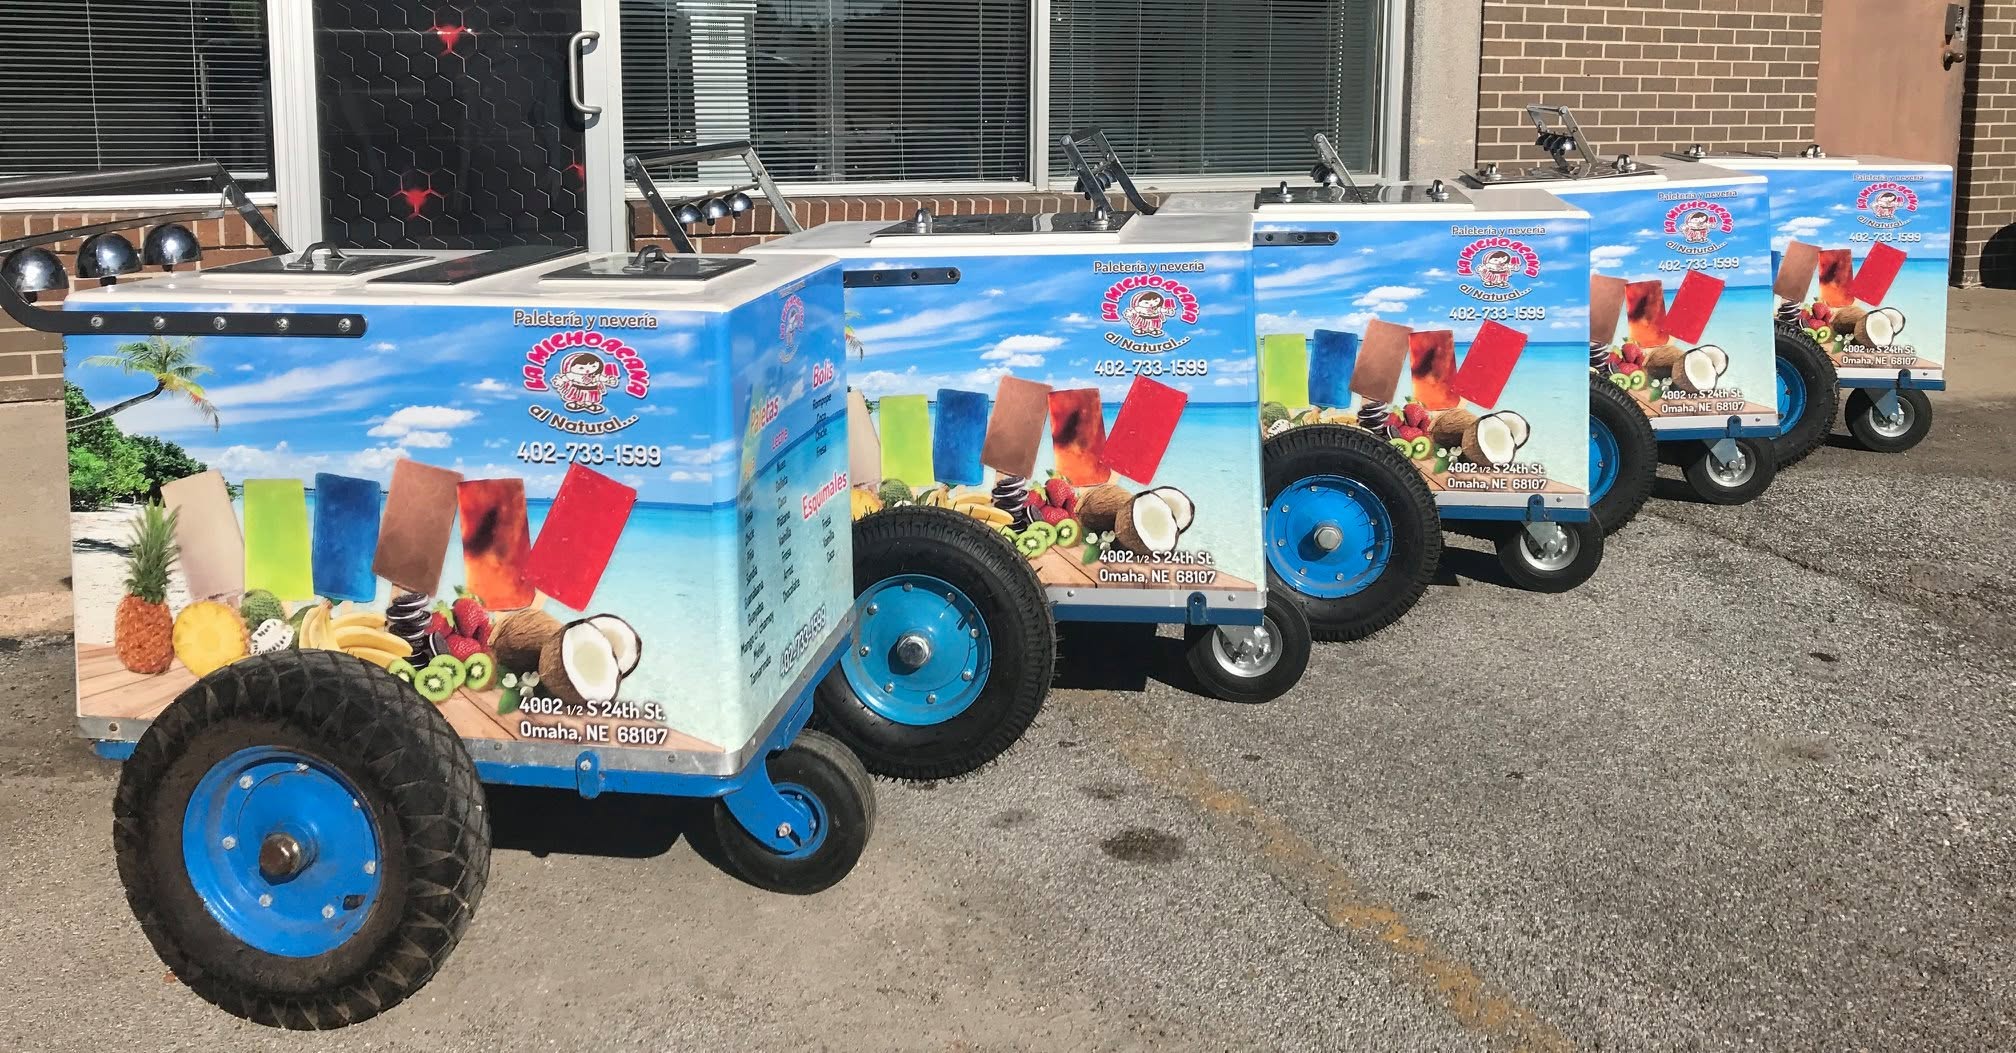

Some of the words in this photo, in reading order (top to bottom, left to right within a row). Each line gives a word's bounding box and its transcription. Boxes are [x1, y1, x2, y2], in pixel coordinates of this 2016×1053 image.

[1452, 225, 1497, 236] Paletería
[1499, 227, 1505, 237] y
[1507, 225, 1546, 235] nevería
[1849, 232, 1921, 242] 402-733-1599
[1666, 241, 1678, 250] al
[1460, 237, 1540, 278] MICHOACANA
[1658, 257, 1740, 271] 402-733-1599
[1094, 261, 1147, 273] Paletería
[1149, 263, 1157, 275] y
[1160, 260, 1205, 272] nevería
[1457, 260, 1473, 275] LA
[1459, 284, 1473, 295] al
[1105, 275, 1201, 324] MICHOACANA
[1102, 302, 1119, 321] LA
[1449, 306, 1546, 320] 402-733-1599
[514, 310, 582, 328] Paletería
[586, 314, 596, 330] y
[599, 313, 658, 328] nevería
[1104, 331, 1122, 345] al
[1121, 336, 1191, 353] Natural...
[1842, 344, 1865, 353] 4002
[1876, 345, 1882, 354] S
[1883, 345, 1903, 354] 24th
[527, 331, 651, 399] MICHOACANA
[1094, 359, 1207, 377] 402-733-1599
[1842, 356, 1873, 365] Omaha,
[1875, 357, 1887, 365] NE
[1890, 357, 1917, 366] 68107
[523, 364, 549, 391] LA
[813, 360, 834, 388] Bolis
[1661, 390, 1686, 400] 4002
[1699, 390, 1706, 400] S
[1707, 389, 1728, 399] 24th
[1731, 388, 1744, 398] St.
[1661, 403, 1697, 413] Omaha,
[1698, 402, 1712, 412] NE
[1716, 401, 1745, 411] 68107
[528, 404, 549, 422] al
[549, 413, 640, 435] Natural...
[750, 395, 779, 437] Paletas
[516, 441, 662, 467] 402-733-1599
[1447, 462, 1477, 473] 4002
[1480, 466, 1491, 474] 1/2
[1493, 462, 1500, 474] S
[1502, 463, 1528, 474] 24th
[1530, 463, 1546, 474] St.
[1447, 477, 1489, 490] Omaha,
[1492, 478, 1508, 489] NE
[1512, 478, 1547, 490] 68107
[802, 471, 847, 519] Esquimales
[1099, 550, 1134, 563] 4002
[1137, 555, 1149, 564] 1/2
[1152, 550, 1161, 564] S
[1163, 551, 1194, 565] 24th
[1197, 551, 1215, 565] St.
[1100, 568, 1148, 583] Omaha,
[1151, 570, 1170, 583] NE
[1176, 570, 1216, 583] 68107
[780, 605, 826, 678] 402-733-1599
[519, 697, 563, 715] 4002
[567, 704, 583, 716] 1/2
[587, 700, 597, 716] S
[602, 701, 639, 719] 24th
[644, 702, 666, 720] St.
[520, 720, 582, 742] Omaha,
[586, 724, 609, 742] NE
[617, 727, 668, 745] 68107
